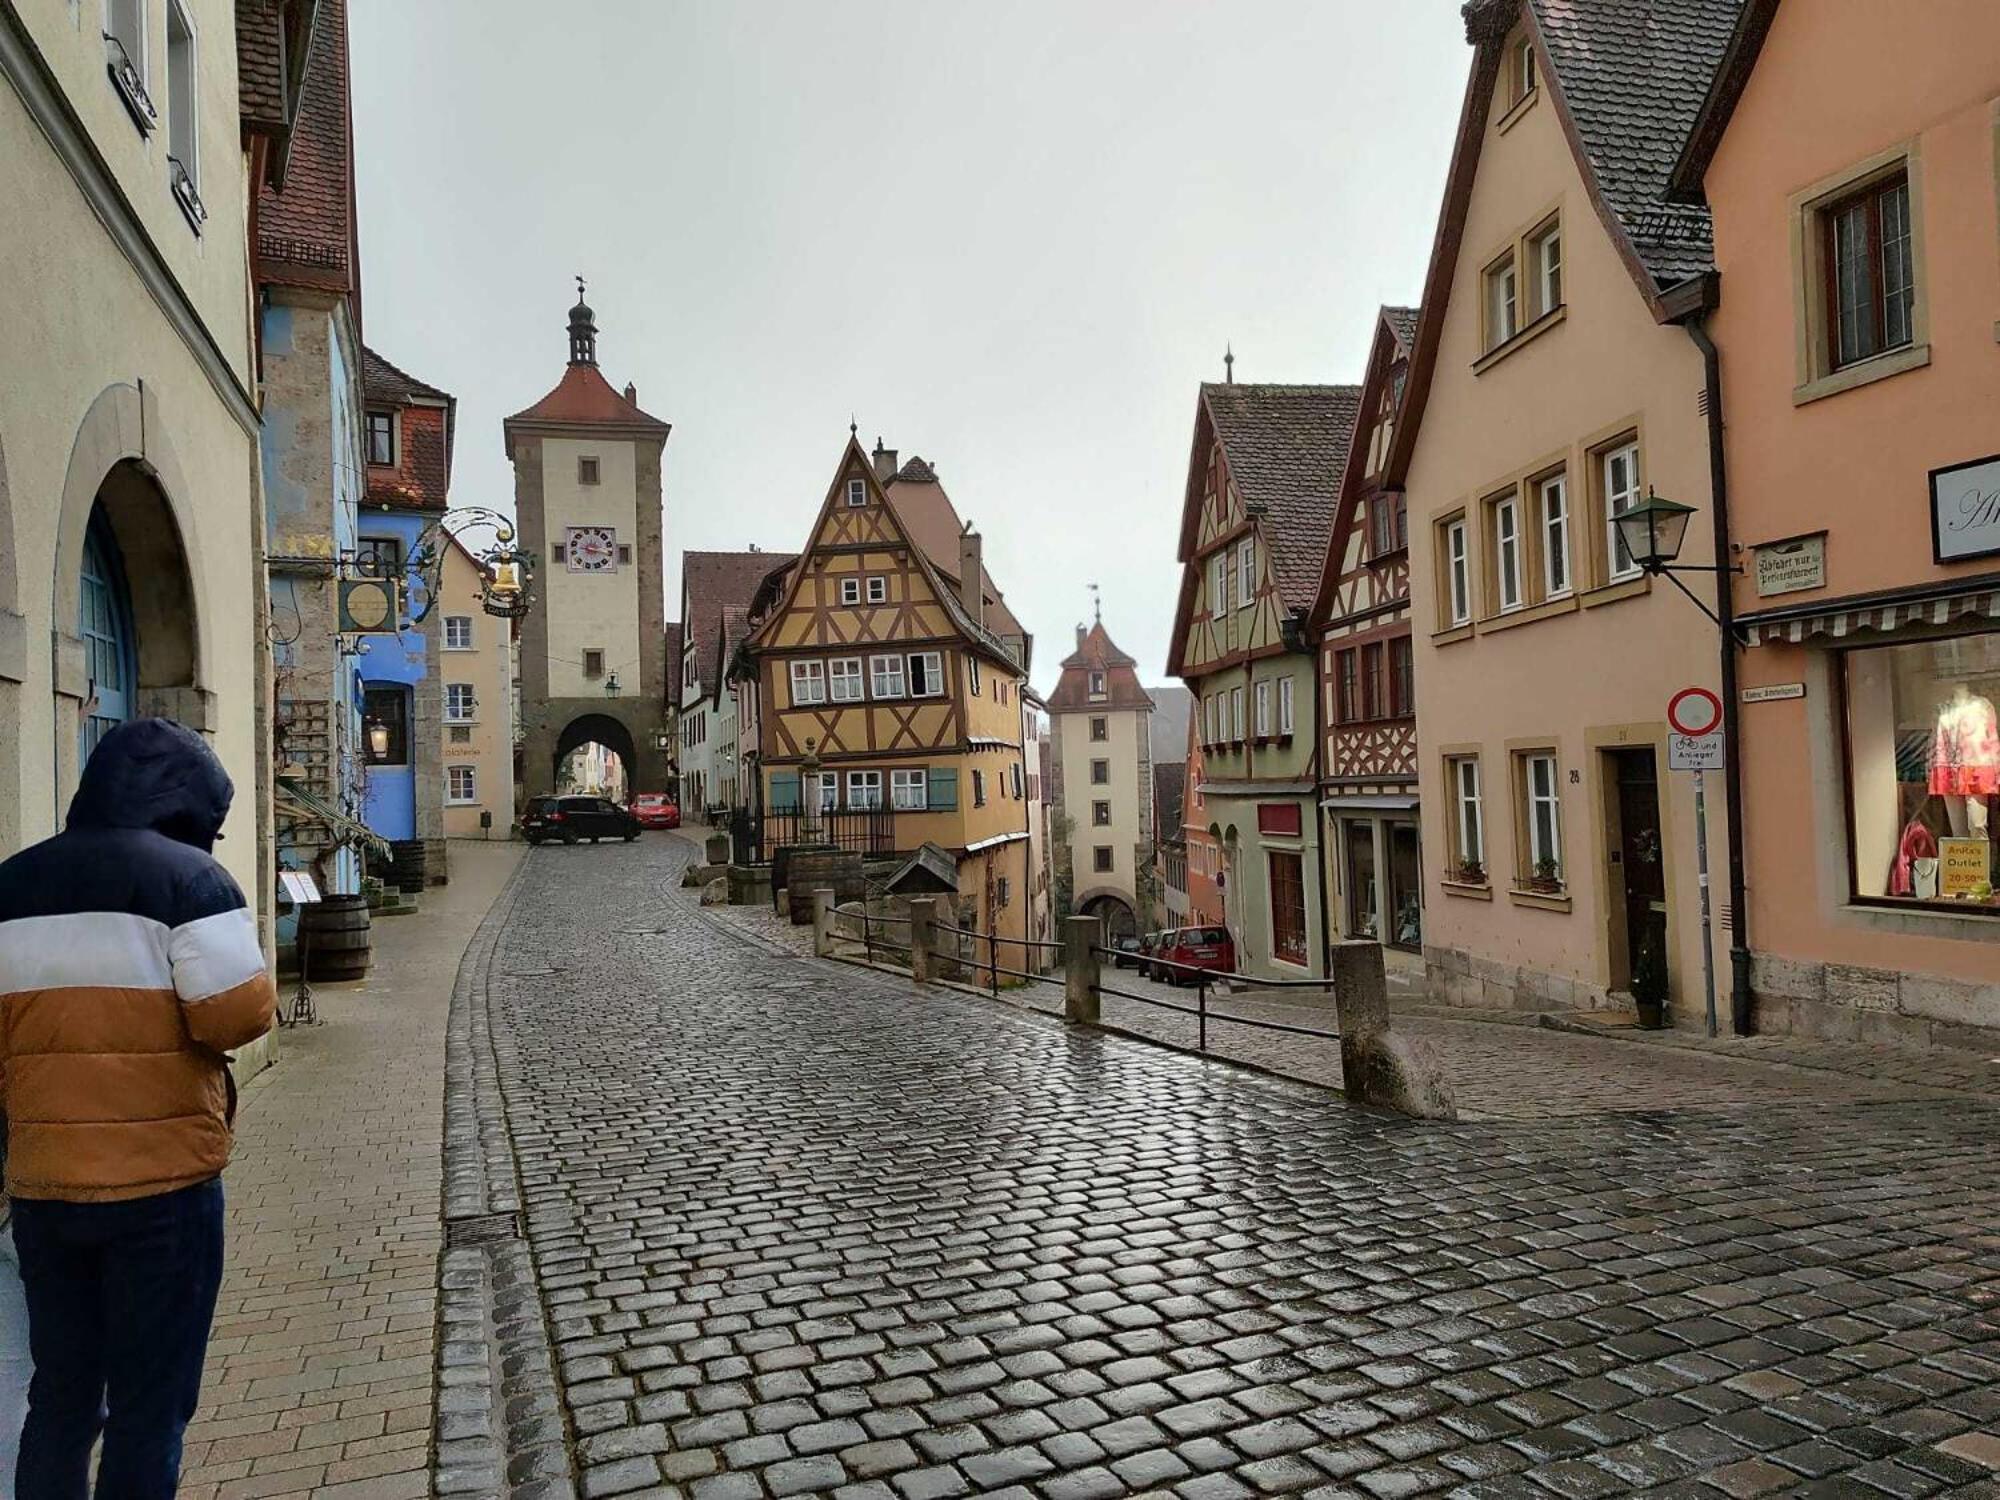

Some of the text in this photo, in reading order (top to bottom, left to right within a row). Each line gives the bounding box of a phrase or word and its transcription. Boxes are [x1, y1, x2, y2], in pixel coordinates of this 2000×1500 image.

[1794, 556, 1810, 567] nur
[1701, 741, 1717, 750] und
[1678, 751, 1714, 760] Anlieger
[1947, 858, 1982, 868] Outlet
